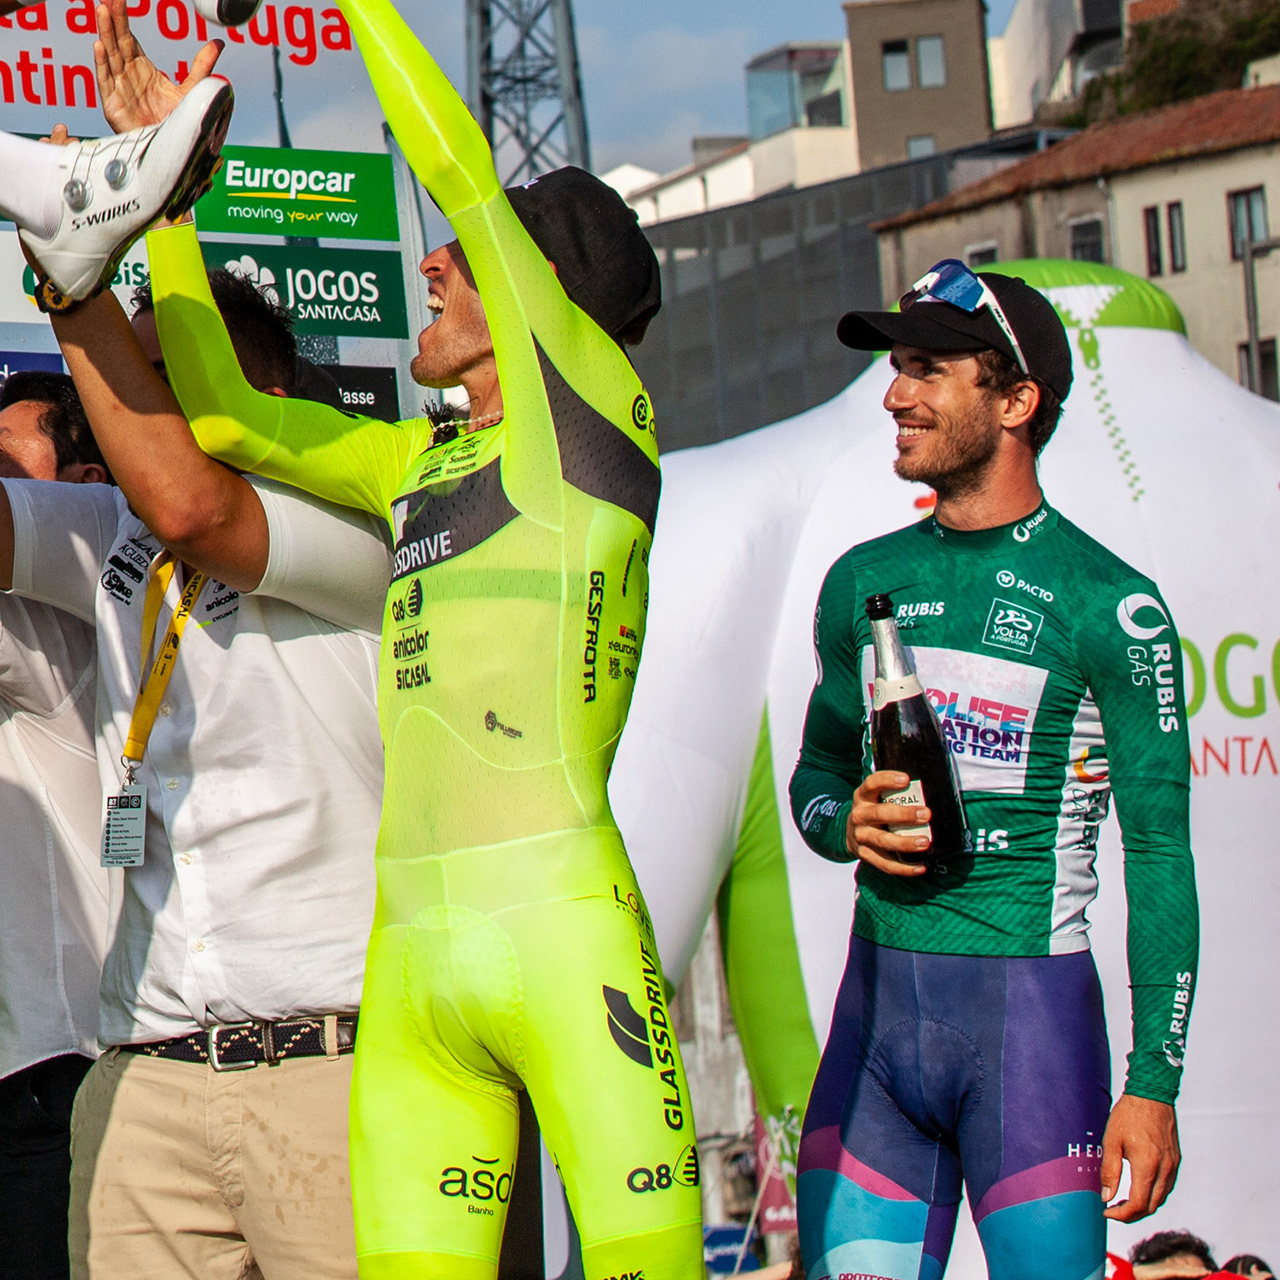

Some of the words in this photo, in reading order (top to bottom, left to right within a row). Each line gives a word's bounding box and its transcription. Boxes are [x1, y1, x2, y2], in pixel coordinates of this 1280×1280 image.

[225, 160, 356, 200] Europcar
[70, 198, 141, 232] S-WORKS
[227, 205, 284, 223] moving
[287, 209, 324, 224] your
[326, 211, 359, 227] way
[285, 267, 380, 310] JOGOS
[298, 304, 382, 323] SANTACASA
[176, 573, 203, 620] SICASAL
[205, 590, 240, 613] anicolo
[1016, 579, 1055, 604] PACTO
[391, 598, 405, 623] Q8
[393, 628, 430, 660] anicolor
[583, 569, 606, 705] GESFROTA
[993, 624, 1029, 643] VOLTA
[996, 635, 1027, 648] PORTUGAL
[395, 662, 432, 691] SICASAL
[1126, 645, 1153, 687] GÁS
[974, 741, 1021, 764] TEAM
[640, 938, 684, 1132] GLASSDRIVE
[626, 1163, 672, 1193] Q8
[466, 1204, 494, 1218] Banho
